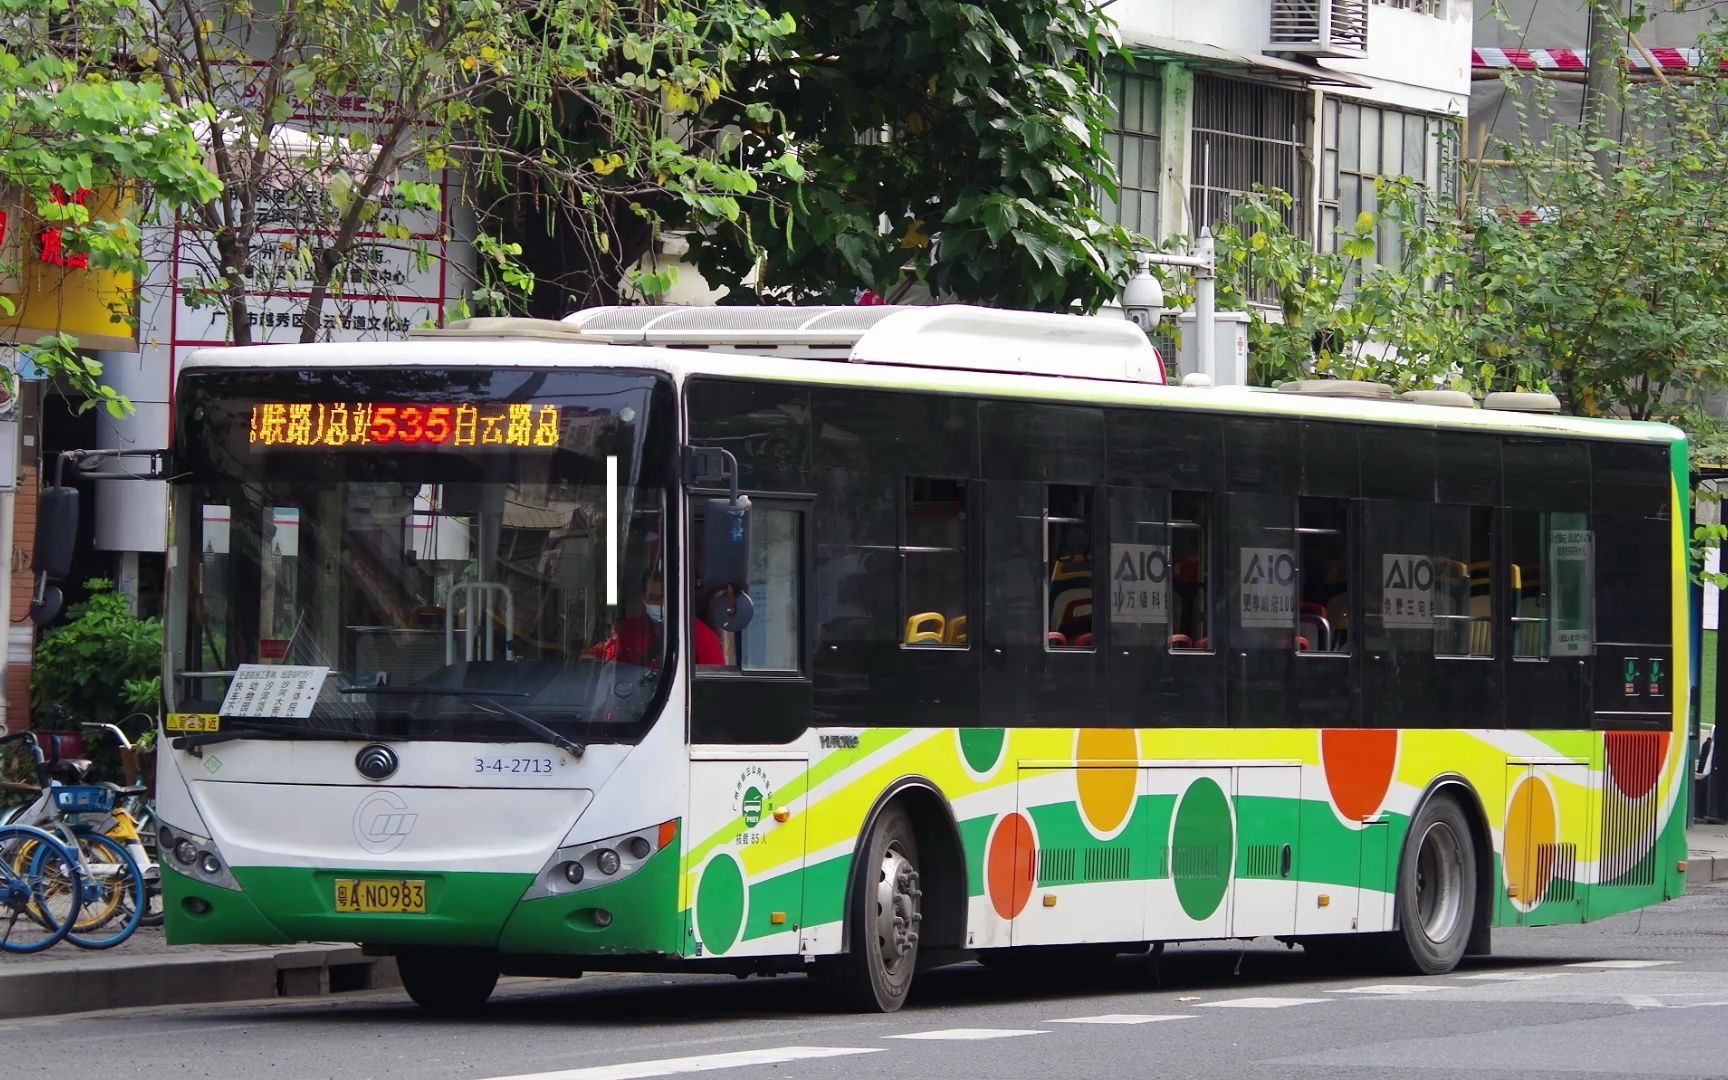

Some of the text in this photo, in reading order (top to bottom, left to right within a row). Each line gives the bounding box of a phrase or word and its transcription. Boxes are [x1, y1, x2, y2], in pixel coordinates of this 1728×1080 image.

[211, 311, 412, 333] 广市越秀区云街道文化站
[371, 406, 452, 443] 535
[454, 402, 559, 446] 白云路总
[1384, 559, 1434, 592] AIO
[819, 735, 860, 749] YUTONG
[475, 758, 553, 773] 3-4-2713
